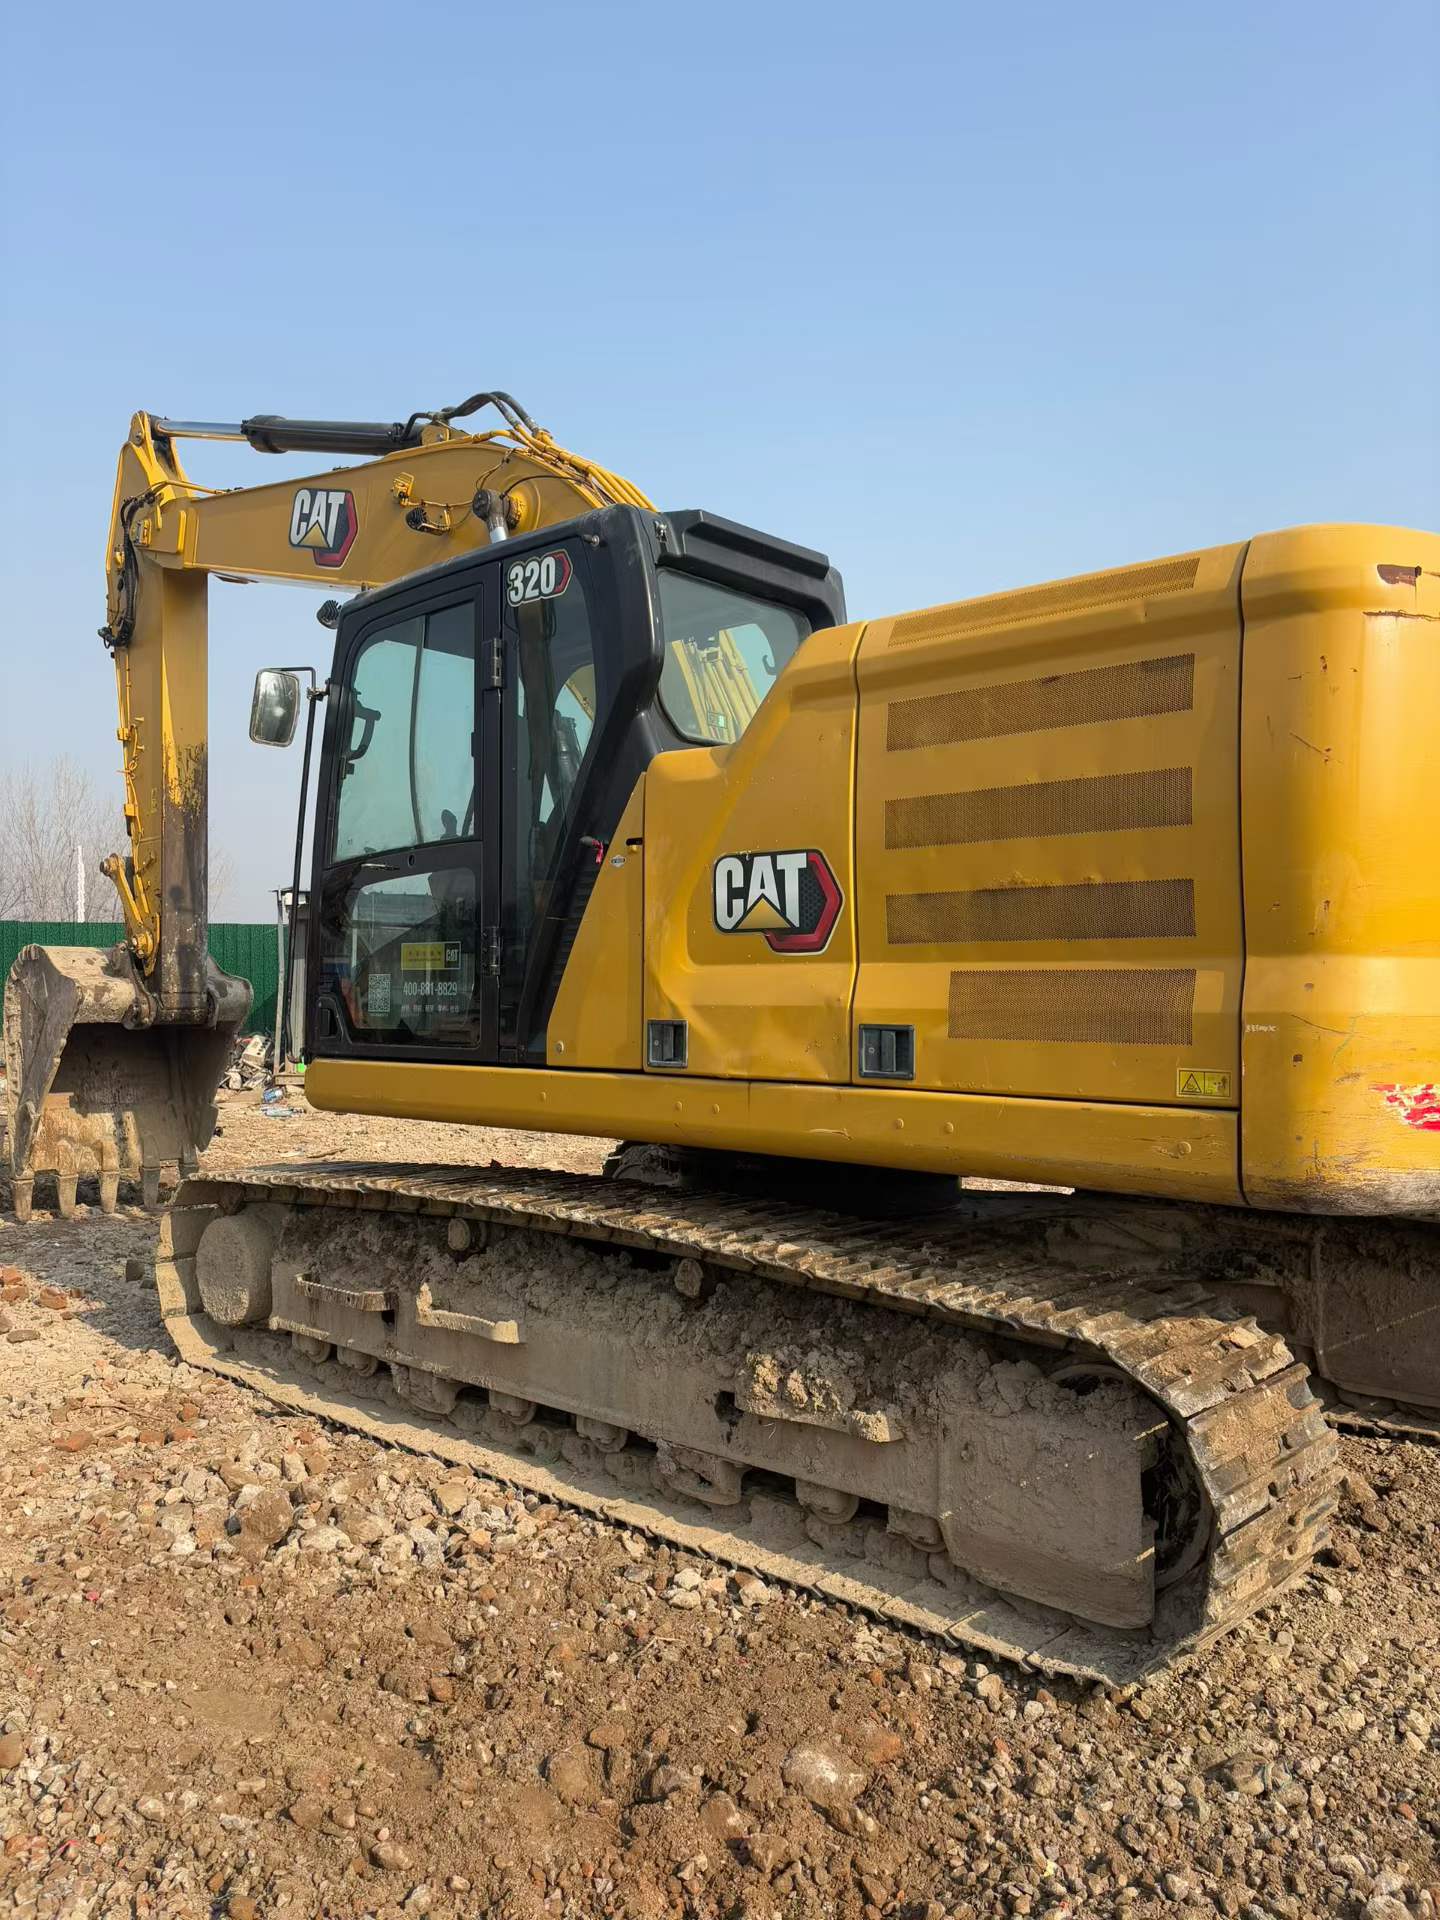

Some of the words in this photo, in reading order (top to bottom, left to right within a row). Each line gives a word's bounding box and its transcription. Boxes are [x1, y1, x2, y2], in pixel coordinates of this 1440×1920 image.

[290, 489, 346, 548] CAT
[509, 556, 556, 602] 320
[715, 852, 807, 930] CAT
